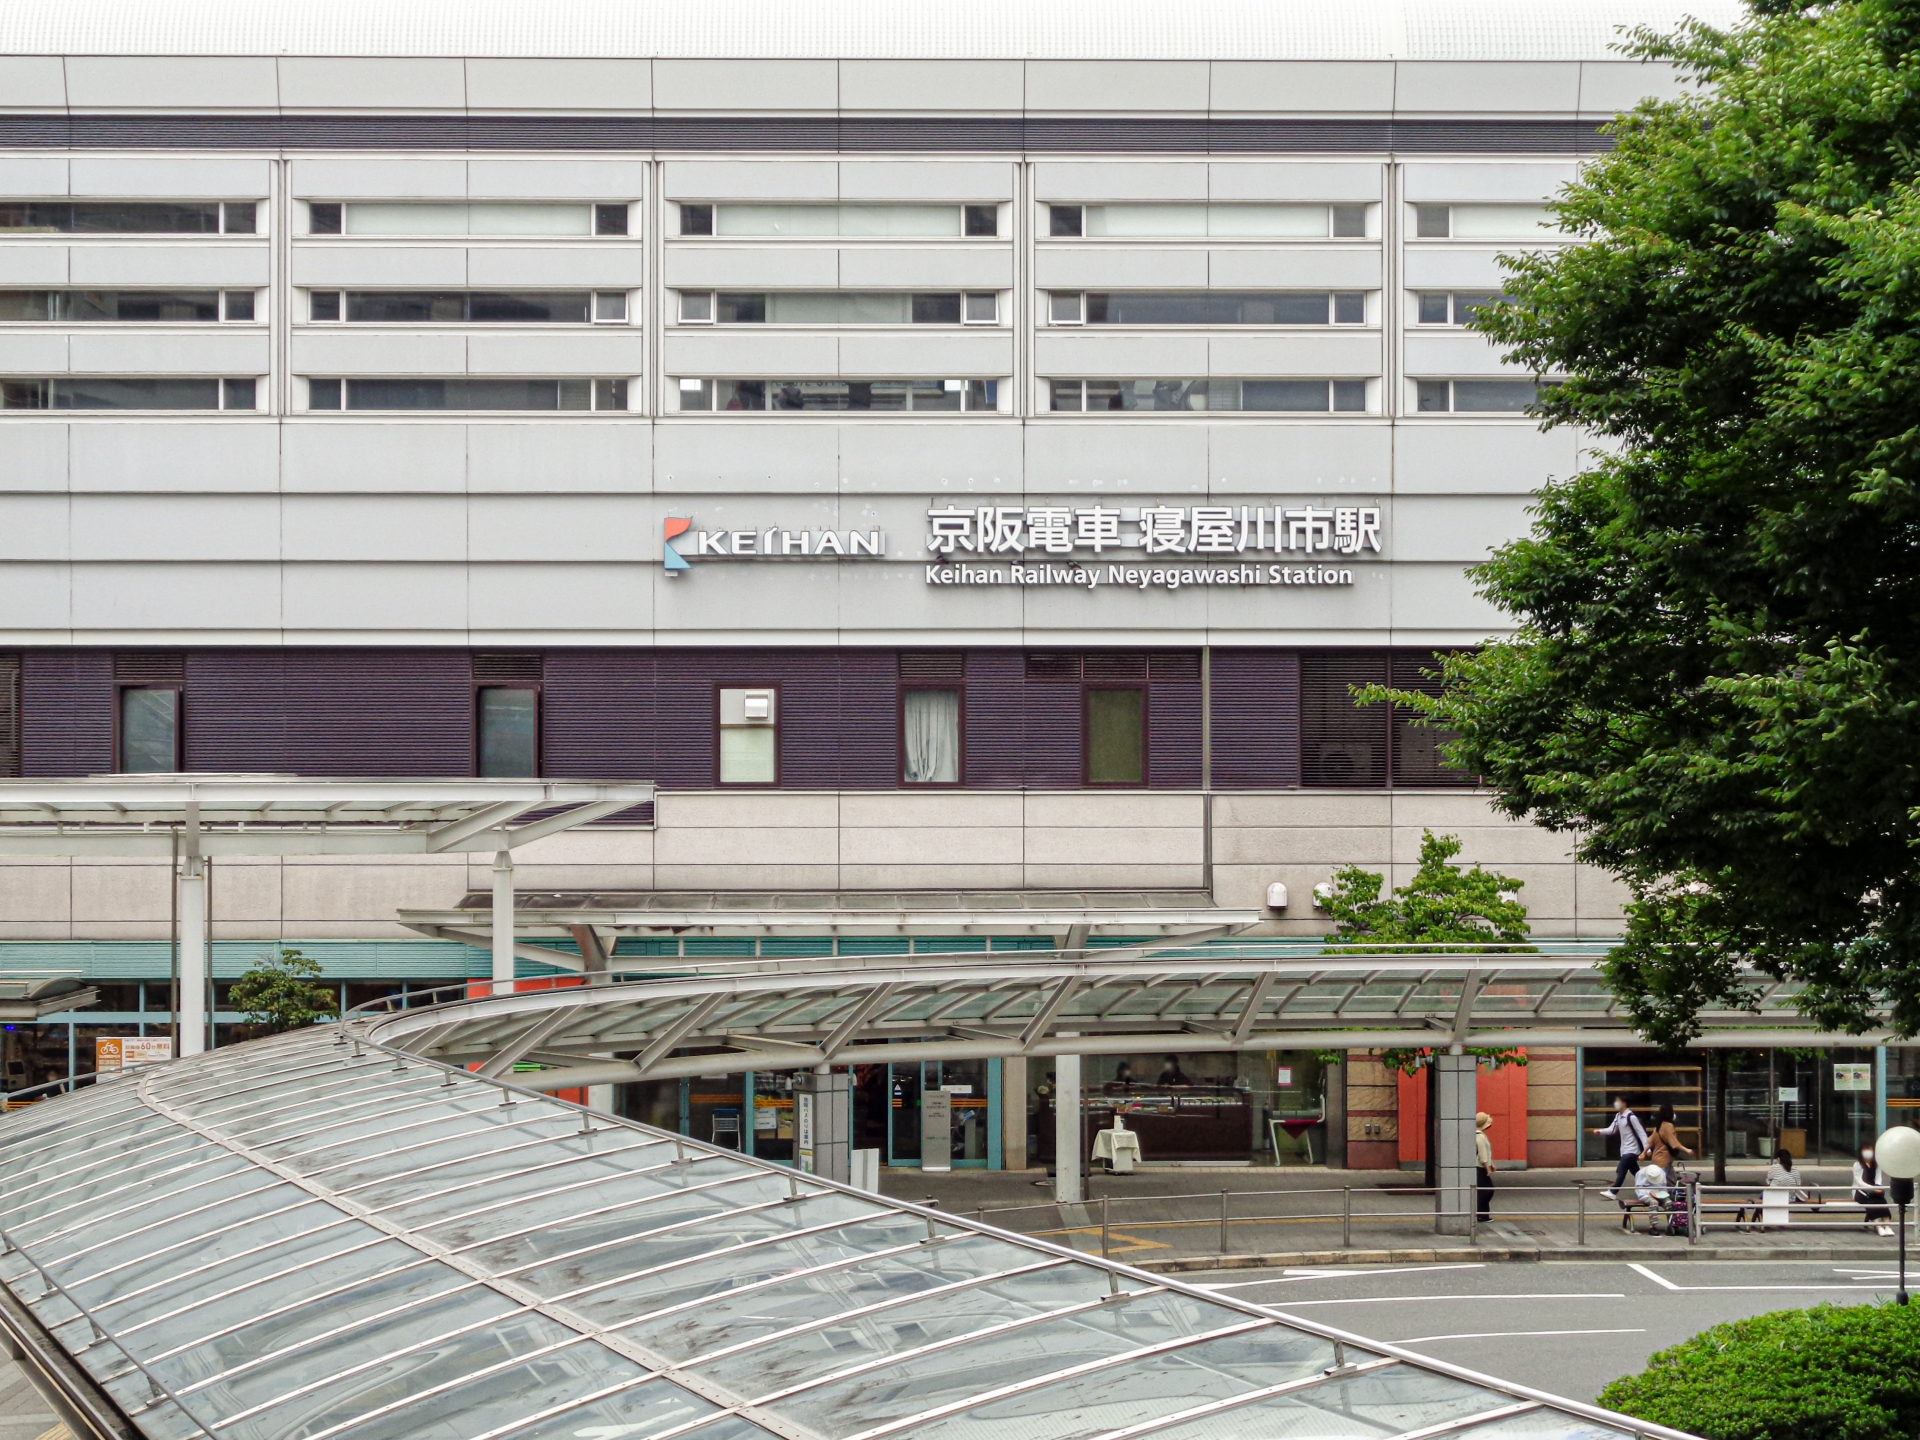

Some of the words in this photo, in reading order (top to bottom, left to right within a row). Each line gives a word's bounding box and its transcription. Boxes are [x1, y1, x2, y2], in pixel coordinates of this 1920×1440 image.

[698, 526, 879, 555] KEIHAN
[927, 504, 1121, 553] 京阪電車
[1139, 504, 1382, 554] 寝屋川市駅
[925, 564, 1002, 584] Keihan
[1010, 564, 1100, 589] Railway
[1108, 564, 1261, 589] Neyagawashi
[1268, 564, 1353, 585] Station
